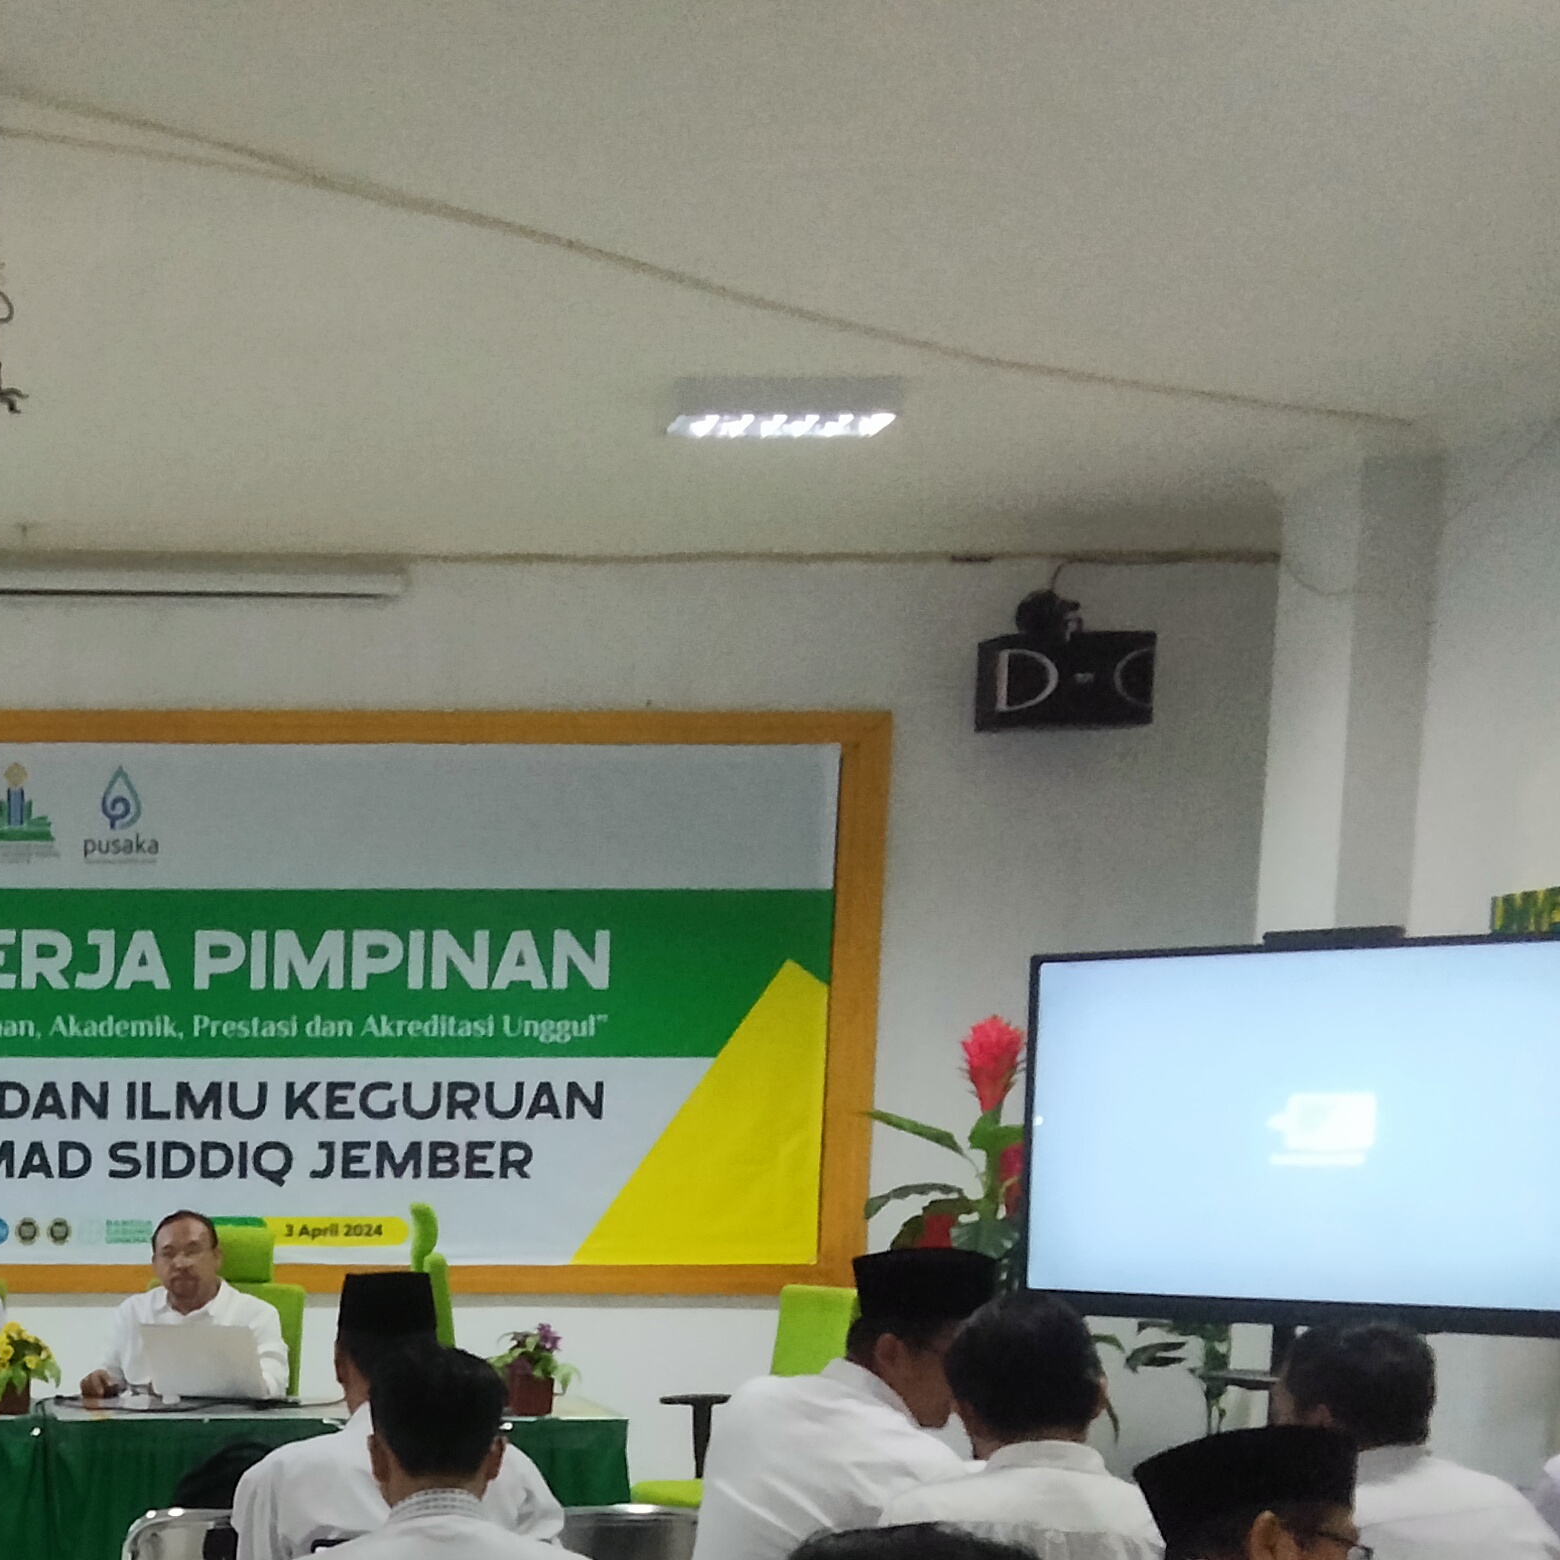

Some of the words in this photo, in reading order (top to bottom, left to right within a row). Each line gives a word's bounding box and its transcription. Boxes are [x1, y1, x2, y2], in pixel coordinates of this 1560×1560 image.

[83, 833, 159, 858] pusaka
[193, 929, 611, 991] PIMPINAN
[49, 1014, 184, 1040] Akademik,
[193, 1014, 298, 1038] Prestasi
[305, 1014, 354, 1038] dan
[361, 1013, 495, 1038] Akreditasi
[126, 1080, 269, 1121] ILMU
[284, 1080, 605, 1121] KEGURUAN
[107, 1140, 294, 1188] SIDDIQ
[309, 1140, 534, 1180] JEMBER
[284, 1224, 294, 1237] 3
[298, 1223, 339, 1240] April
[343, 1223, 383, 1237] 2024
